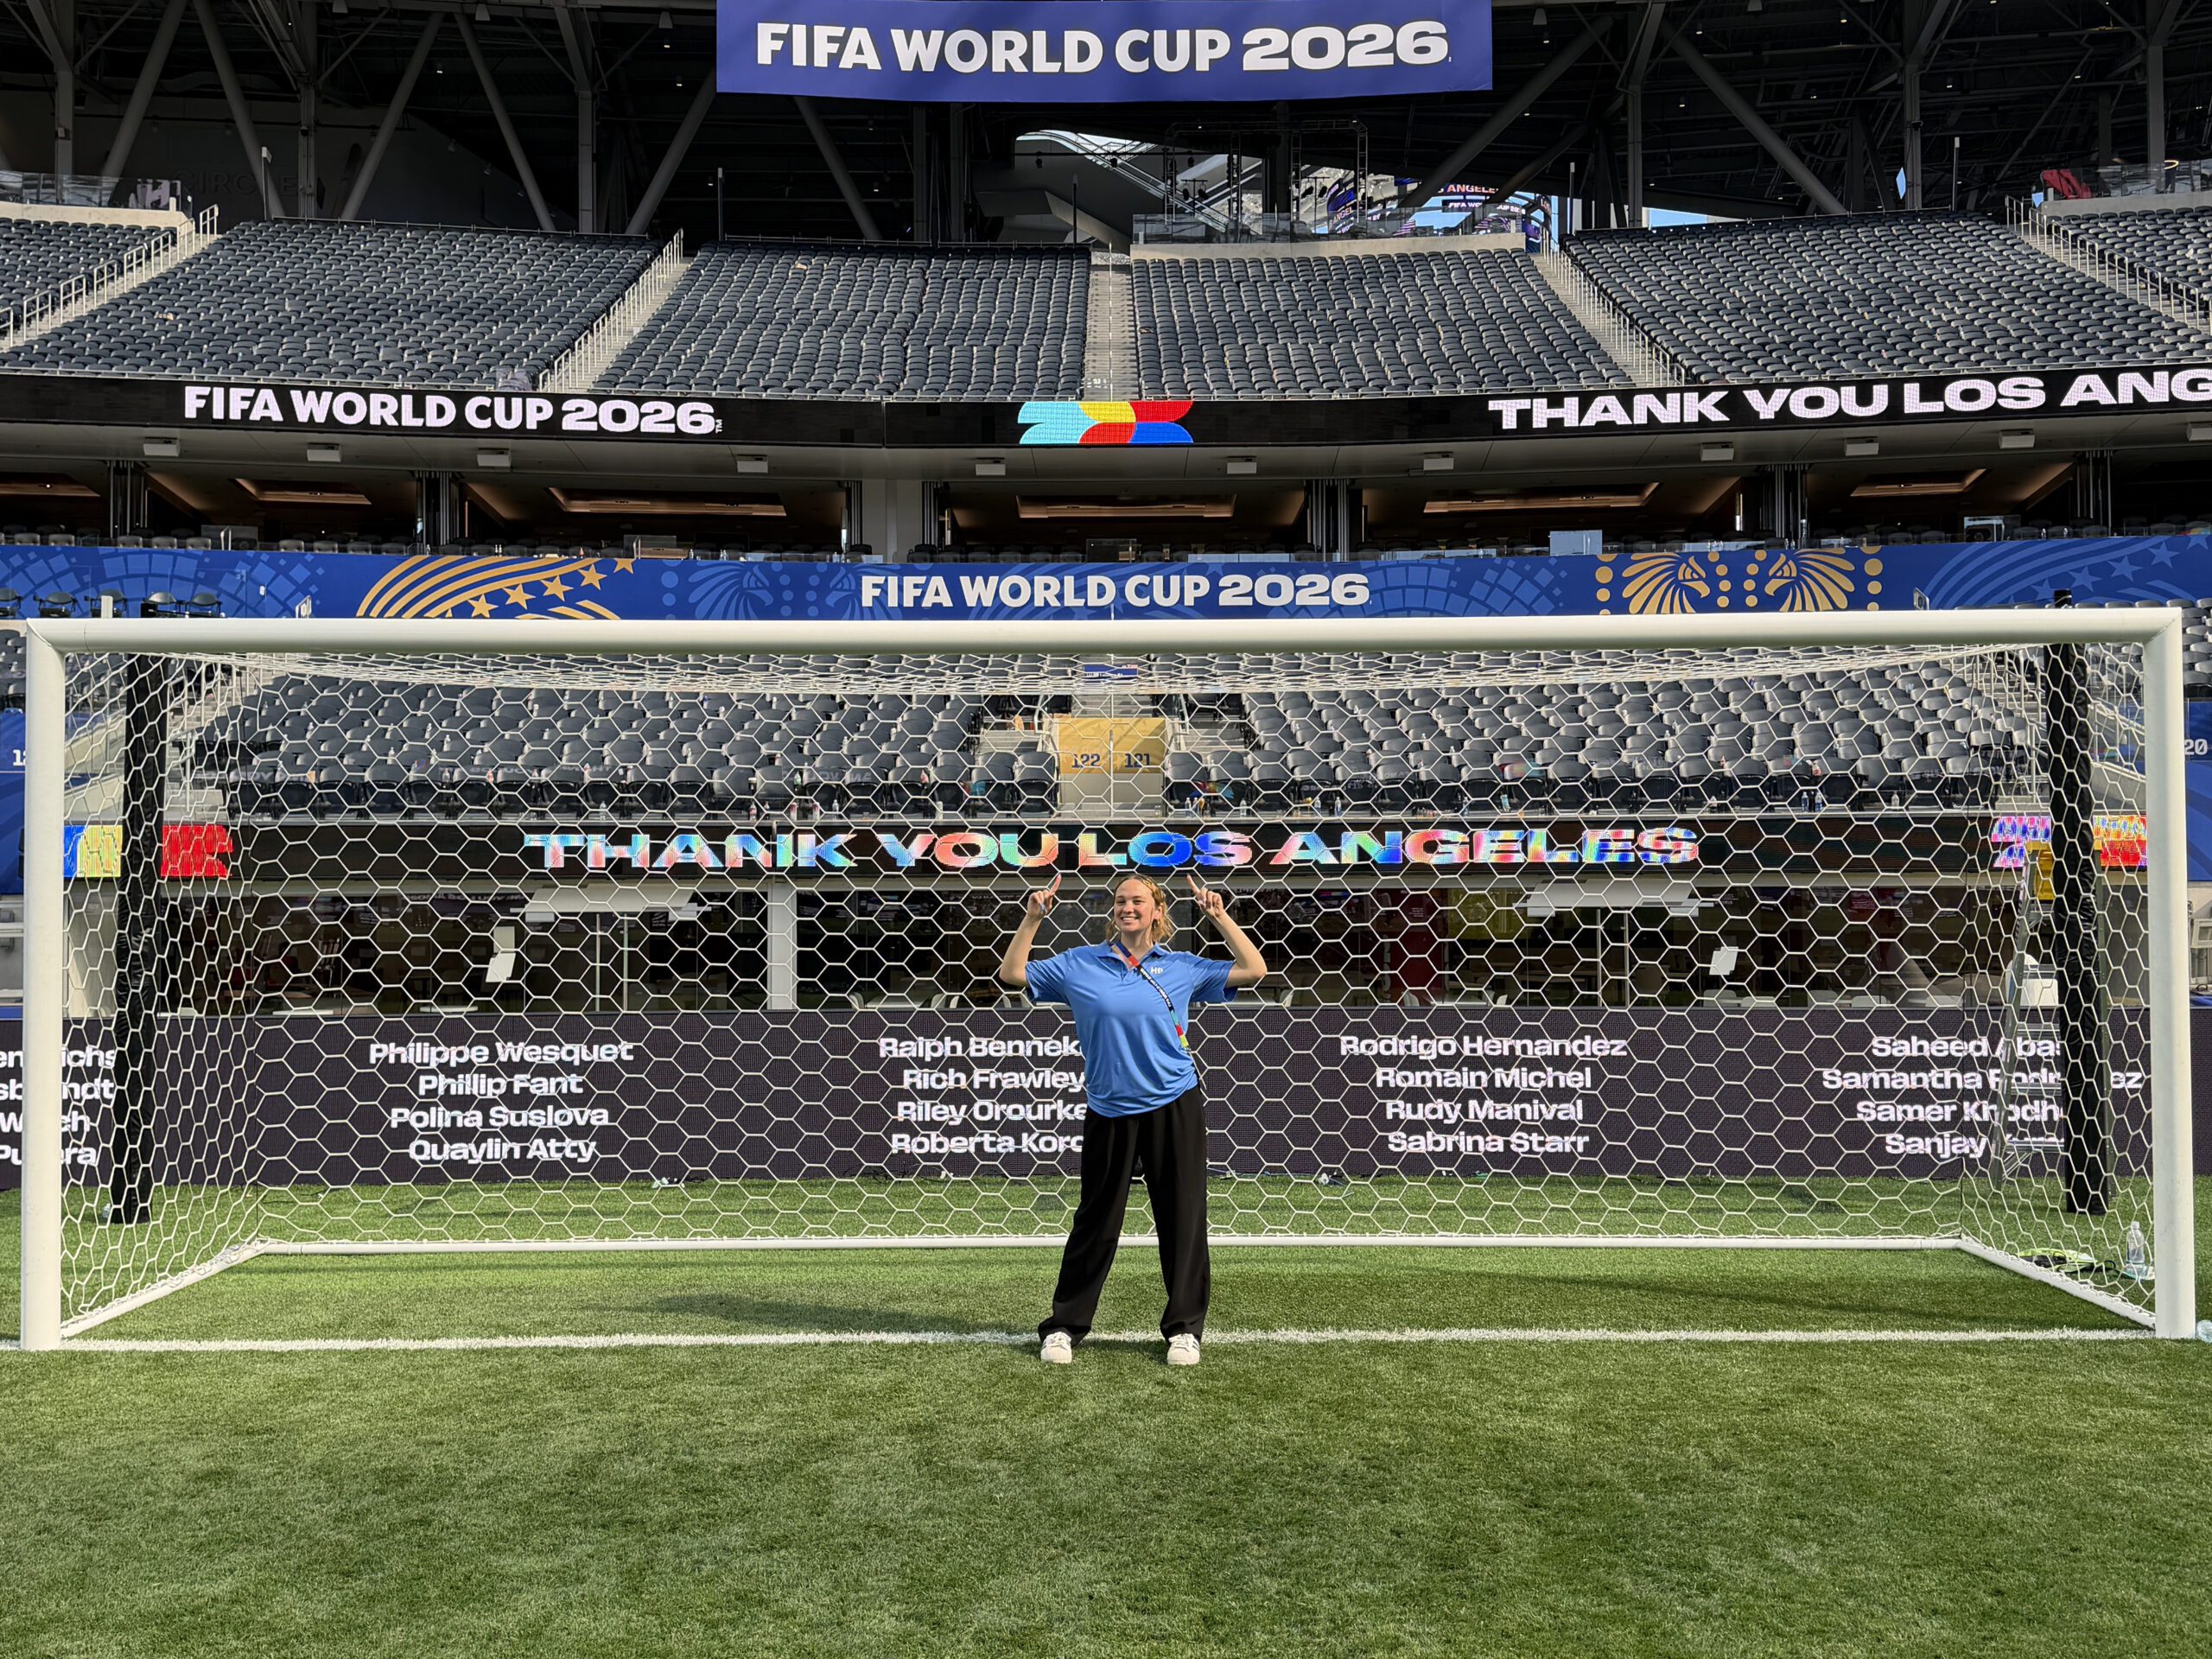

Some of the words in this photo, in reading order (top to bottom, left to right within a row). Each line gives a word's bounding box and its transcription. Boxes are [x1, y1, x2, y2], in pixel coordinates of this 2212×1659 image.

[757, 22, 882, 70] FIFA
[890, 29, 1103, 73] WORLD
[1115, 29, 1230, 73] CUP
[1242, 21, 1449, 71] 2026
[173, 170, 298, 195] CIRCE
[184, 385, 283, 422] FIFA
[289, 390, 456, 428] WORLD
[465, 396, 554, 430] CUP
[562, 398, 715, 435] 2026
[1488, 391, 1730, 429] THANK
[1742, 384, 1889, 419] YOU
[1904, 376, 2046, 414] LOS
[2060, 369, 2212, 408] ANG
[861, 575, 953, 607] FIFA
[959, 575, 1116, 607] WORLD
[1124, 574, 1210, 607] CUP
[1218, 573, 1370, 607] 2026
[1071, 753, 1100, 768] 122
[1125, 753, 1150, 768] 121
[524, 834, 857, 868] THANK
[875, 832, 1059, 868] YOU
[1078, 830, 1253, 867] LOS
[1268, 827, 1699, 866] ANGELES
[369, 1042, 489, 1067] Philippe
[495, 1041, 633, 1065] Wesquet
[879, 1037, 963, 1061] Ralph
[1339, 1035, 1456, 1060] Rodrigo
[1463, 1035, 1628, 1056] Hernandez
[1872, 1036, 1988, 1057] Saheed
[419, 1074, 506, 1097] Phillip
[513, 1074, 582, 1095] Fant
[903, 1069, 966, 1090] Rich
[973, 1070, 1085, 1093] Frawley
[1376, 1068, 1488, 1088] Romain
[1494, 1066, 1591, 1089] Michel
[1822, 1068, 1982, 1090] Samantha
[391, 1107, 482, 1128] Polina
[489, 1105, 609, 1127] Suslova
[897, 1100, 967, 1125] Riley
[973, 1099, 1088, 1121] Orourke
[1385, 1099, 1461, 1124] Rudy
[1468, 1099, 1583, 1121] Manival
[1857, 1100, 1957, 1122] Samer
[409, 1138, 520, 1164] Quaylin
[525, 1139, 596, 1163] Atty
[892, 1133, 1015, 1154] Roberta
[1387, 1132, 1503, 1153] Sabrina
[1510, 1131, 1590, 1153] Starr
[1885, 1133, 1987, 1159] Sanjay
